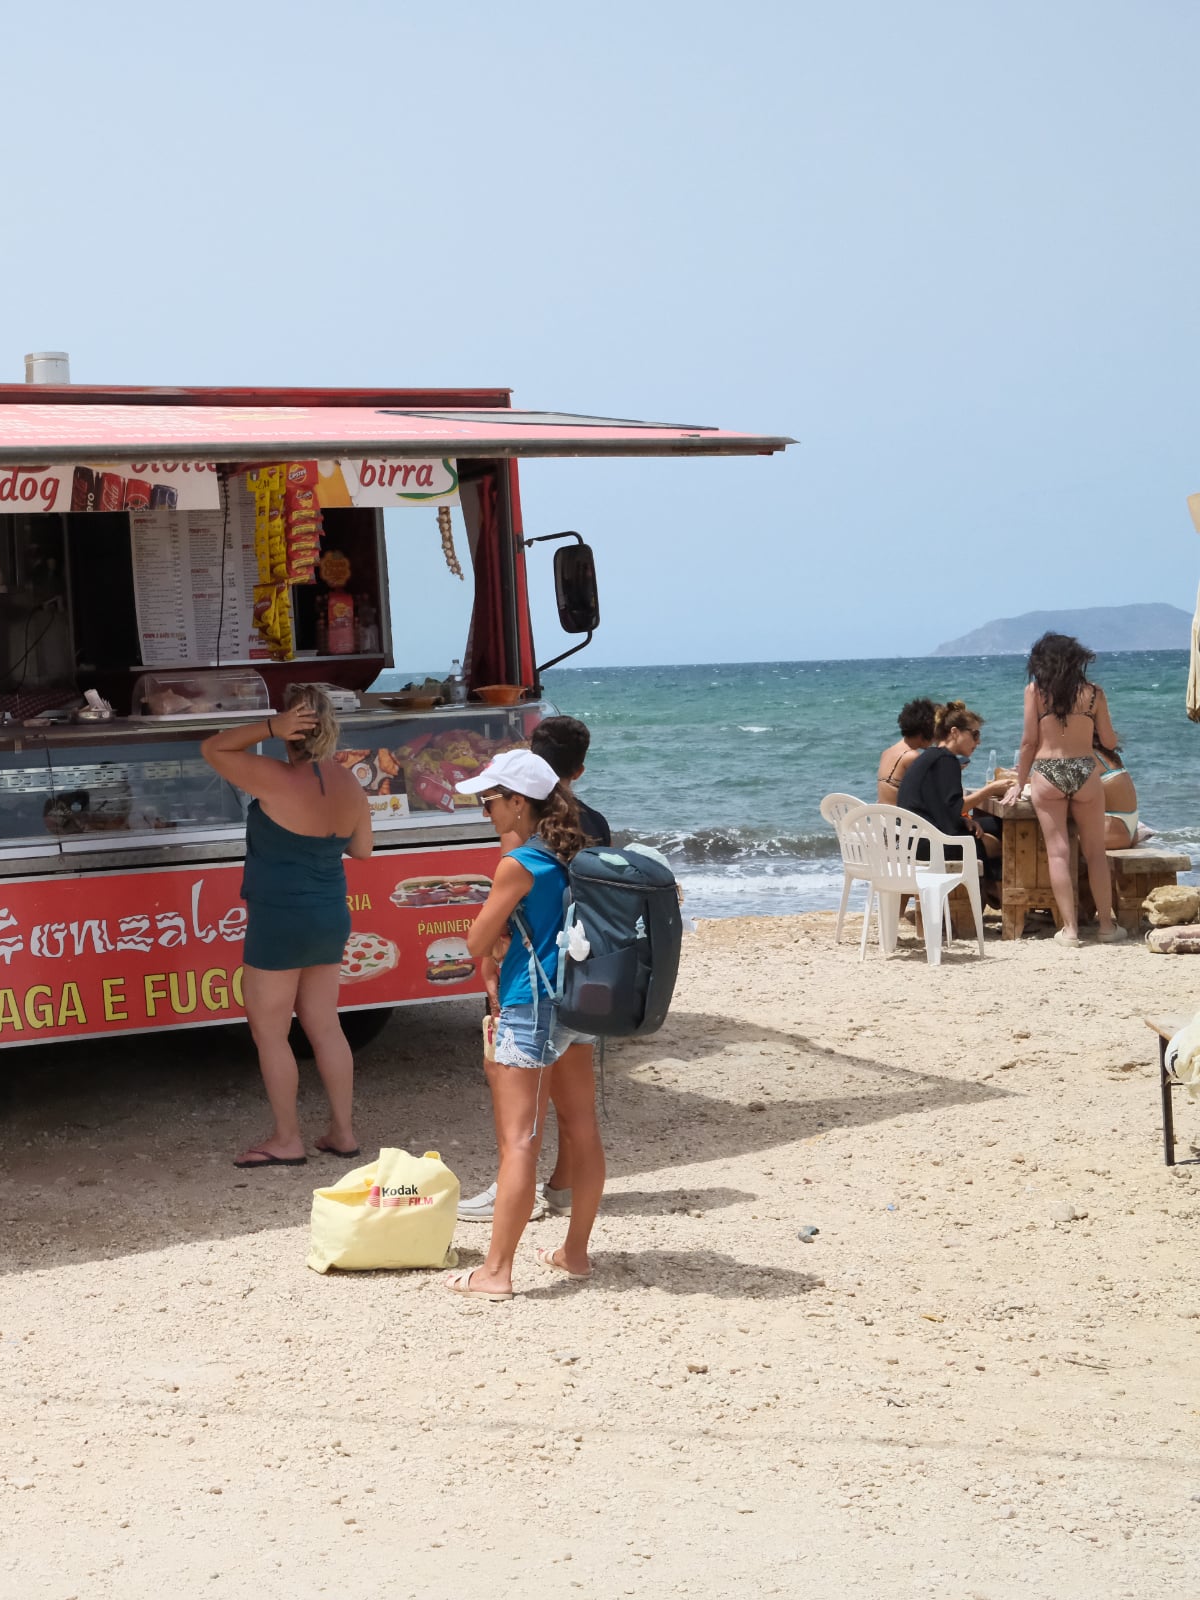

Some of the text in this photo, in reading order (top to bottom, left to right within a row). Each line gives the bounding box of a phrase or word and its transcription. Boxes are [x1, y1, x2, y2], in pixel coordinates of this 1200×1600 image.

[359, 459, 435, 489] birra
[417, 918, 475, 937] PANINER
[102, 976, 129, 1022] E
[143, 966, 246, 1018] FUG
[382, 1184, 418, 1197] Kodak
[408, 1197, 433, 1207] FILM
